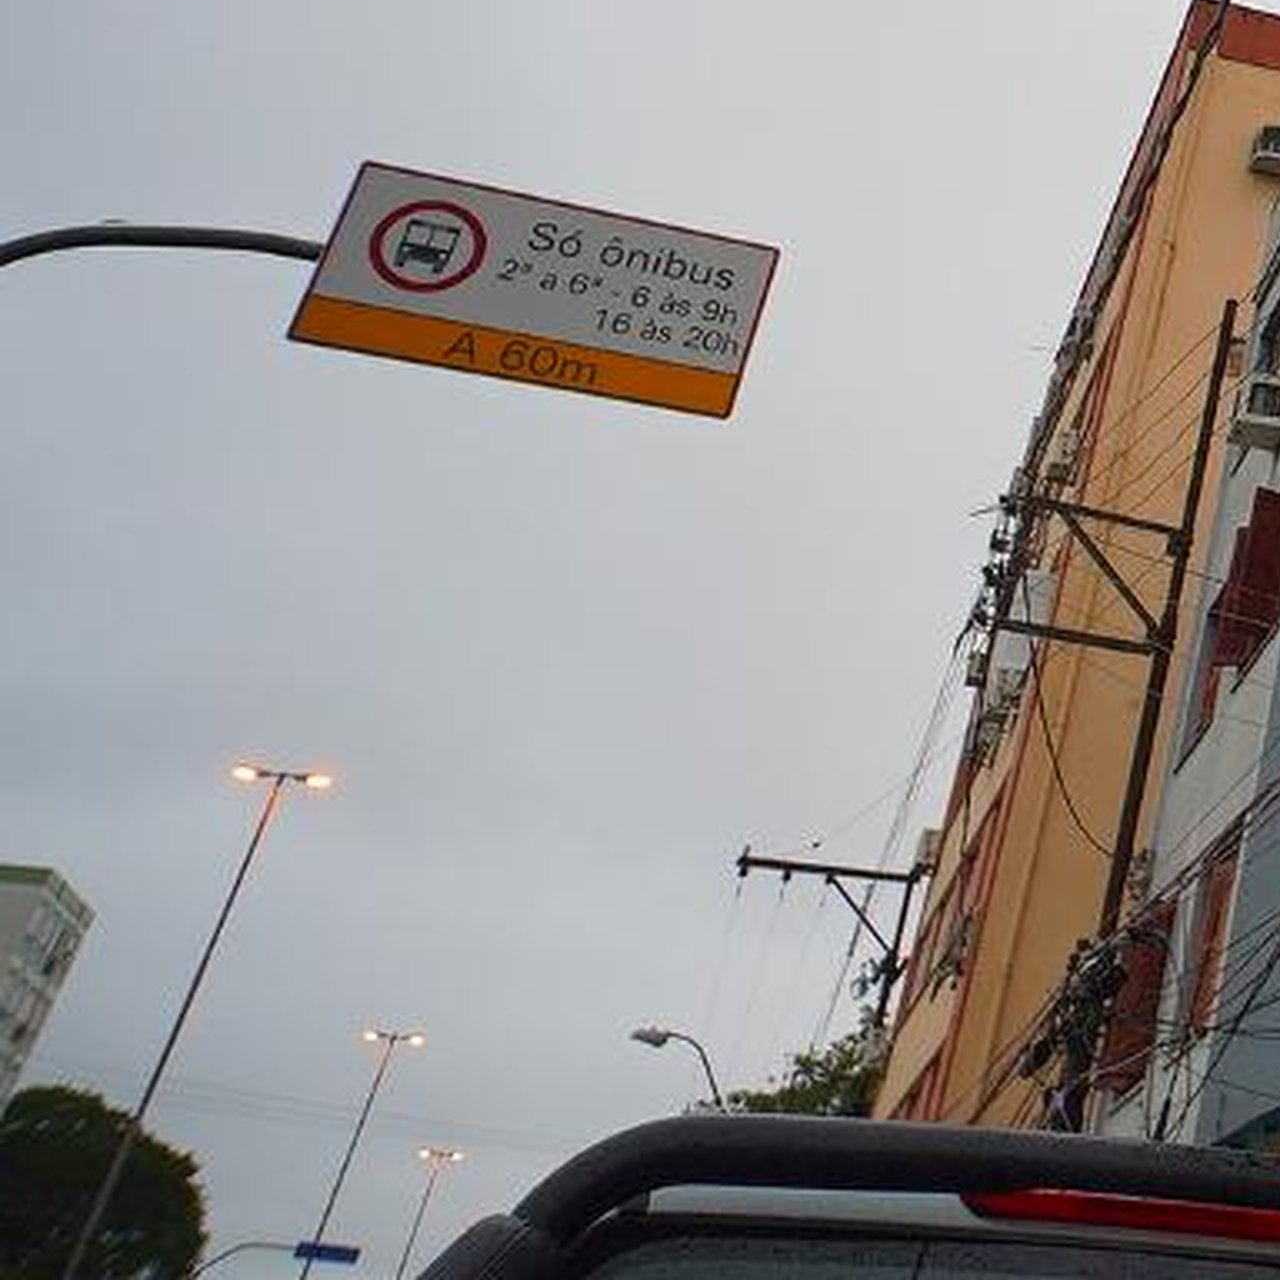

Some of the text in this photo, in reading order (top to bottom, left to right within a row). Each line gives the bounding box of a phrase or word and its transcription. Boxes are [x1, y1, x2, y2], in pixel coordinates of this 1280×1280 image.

[528, 222, 735, 291] Só ônibus
[539, 271, 558, 291] a
[631, 286, 651, 308] 6
[702, 299, 738, 327] 9h
[443, 331, 599, 385] A 60m
[597, 309, 632, 335] 16
[683, 325, 738, 355] 20h
